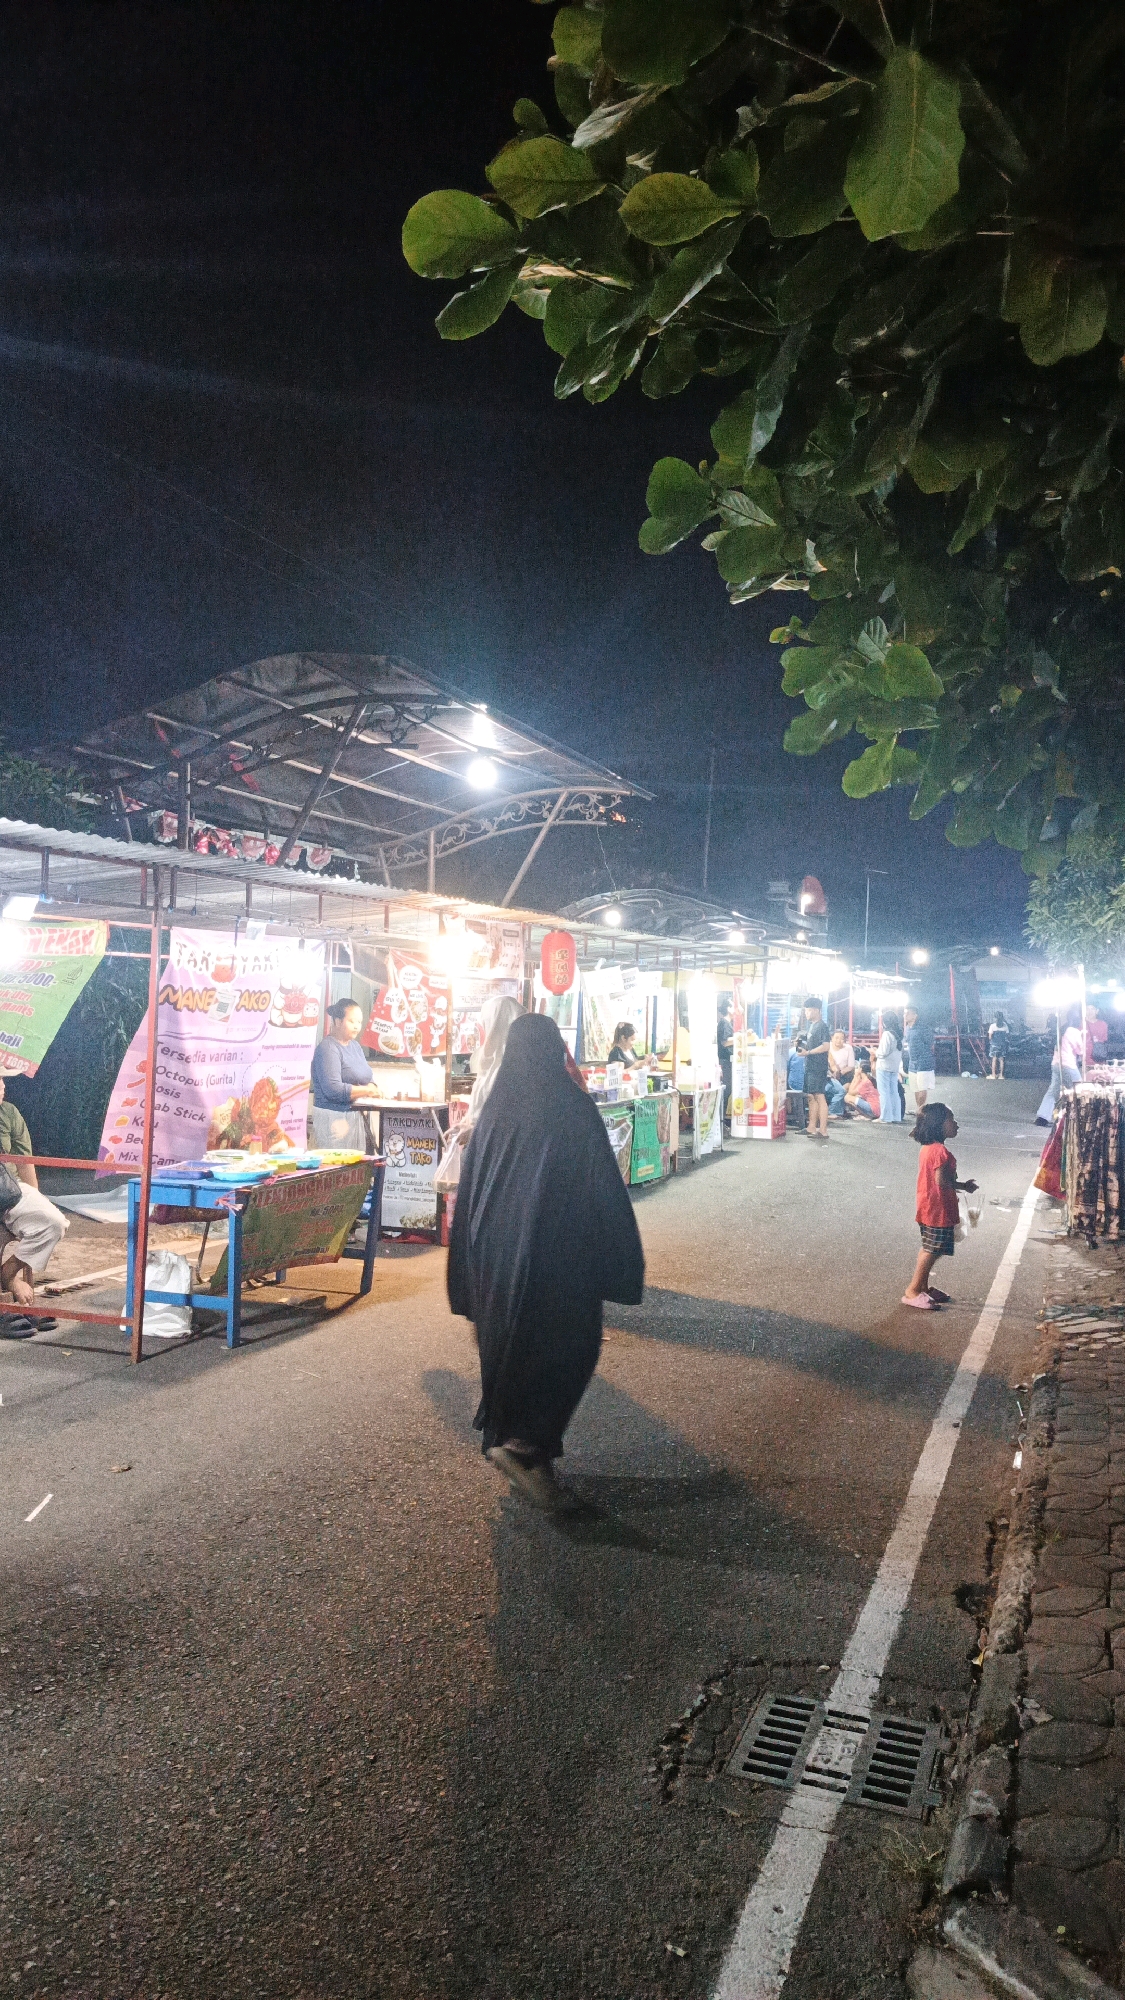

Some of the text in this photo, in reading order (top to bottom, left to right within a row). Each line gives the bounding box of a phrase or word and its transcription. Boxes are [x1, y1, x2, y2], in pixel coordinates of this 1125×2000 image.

[44, 928, 95, 954] ENAK
[235, 988, 271, 1012] AKO
[156, 1041, 206, 1064] Tersedia
[209, 1048, 238, 1062] varian
[155, 1065, 236, 1088] Octopus (Gurita)
[154, 1081, 181, 1099] osis
[139, 1098, 206, 1122] Cab Stick
[131, 1115, 159, 1129] Keu
[387, 1117, 435, 1129] TAKOYAKI
[406, 1136, 436, 1151] MANEKI
[118, 1151, 179, 1166] Mix Cam
[410, 1152, 432, 1166] TAKO
